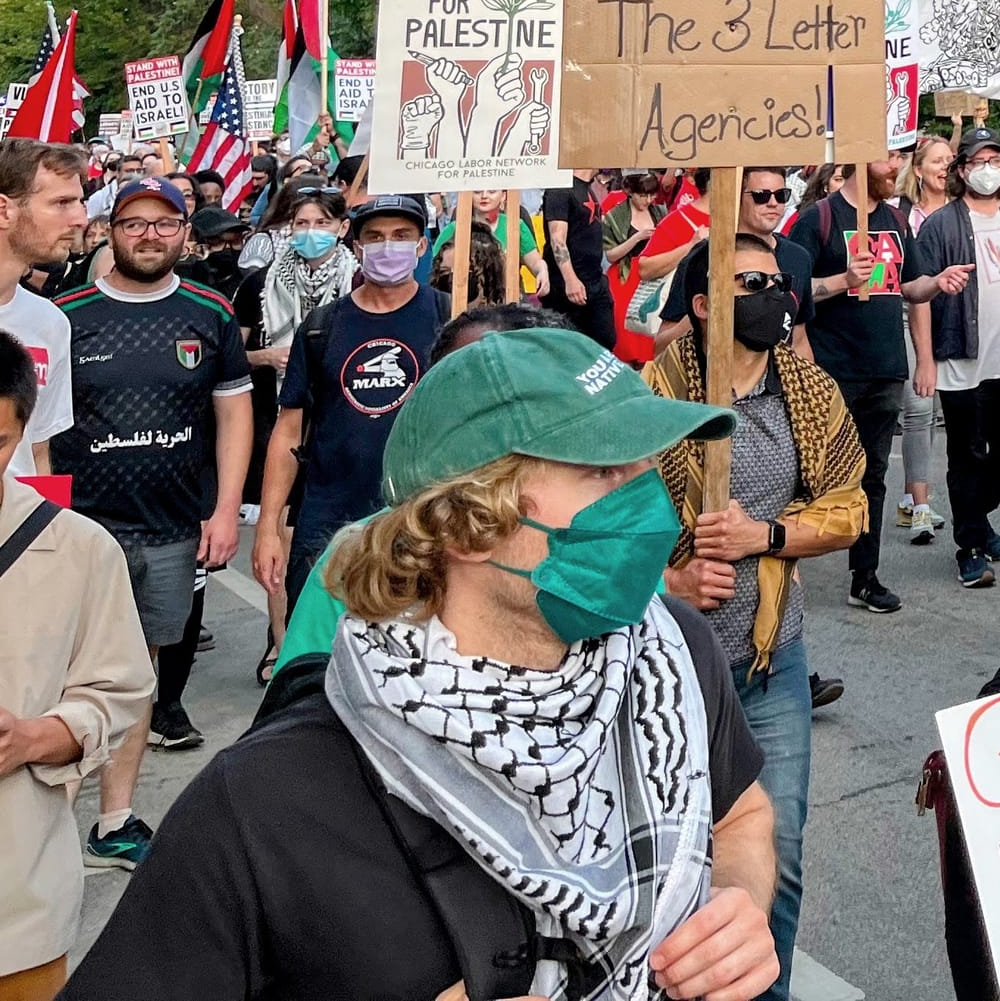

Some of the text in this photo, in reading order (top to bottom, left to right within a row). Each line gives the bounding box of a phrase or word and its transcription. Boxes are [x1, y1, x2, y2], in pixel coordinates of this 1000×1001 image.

[127, 58, 178, 74] STAND WITH
[128, 67, 180, 83] PALESTINE!
[246, 82, 275, 95] TORY
[339, 78, 361, 88] END
[132, 84, 155, 98] END
[339, 88, 375, 98] AID T
[135, 93, 182, 111] AID TO
[340, 99, 368, 109] ISRA
[136, 106, 184, 124] ISRAEL!
[639, 82, 826, 161] Agencies!
[405, 157, 547, 170] CHICAGO LABOR NETWORK
[437, 167, 515, 179] FOR PALESTINE
[352, 376, 407, 390] MARX
[89, 425, 192, 453] الحرية لفلسطين
